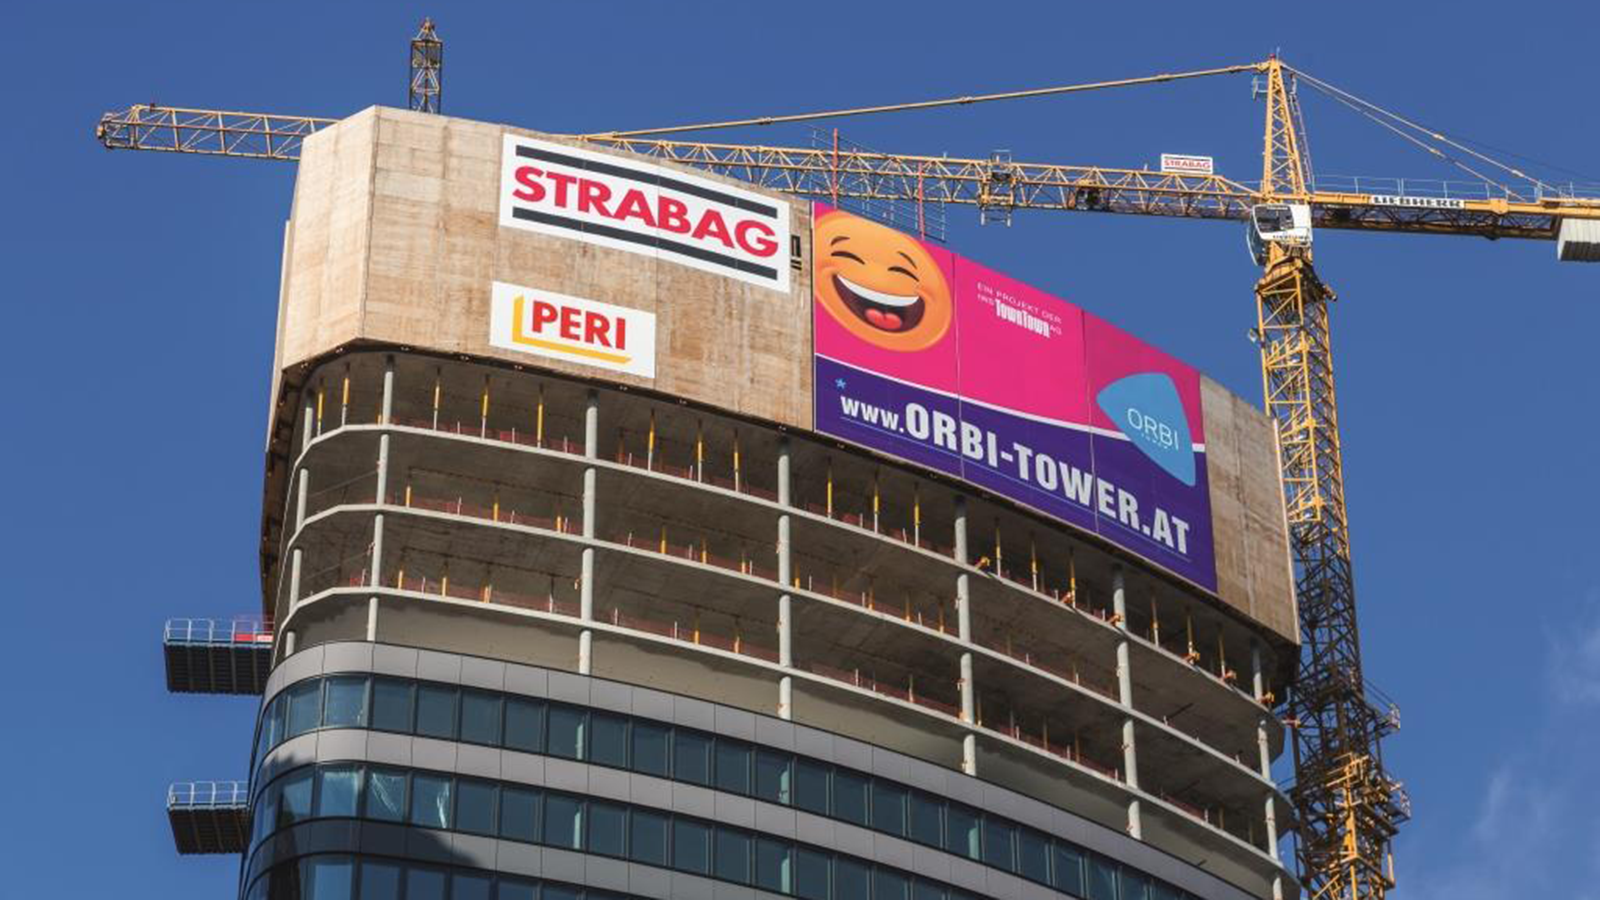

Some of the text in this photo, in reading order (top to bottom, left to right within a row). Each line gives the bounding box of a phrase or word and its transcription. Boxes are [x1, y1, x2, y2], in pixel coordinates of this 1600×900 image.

[512, 165, 779, 258] STRABAG
[531, 300, 626, 350] PERI
[1127, 408, 1179, 451] ORBI
[840, 395, 1190, 555] www.ORBI-TOWER.AT
